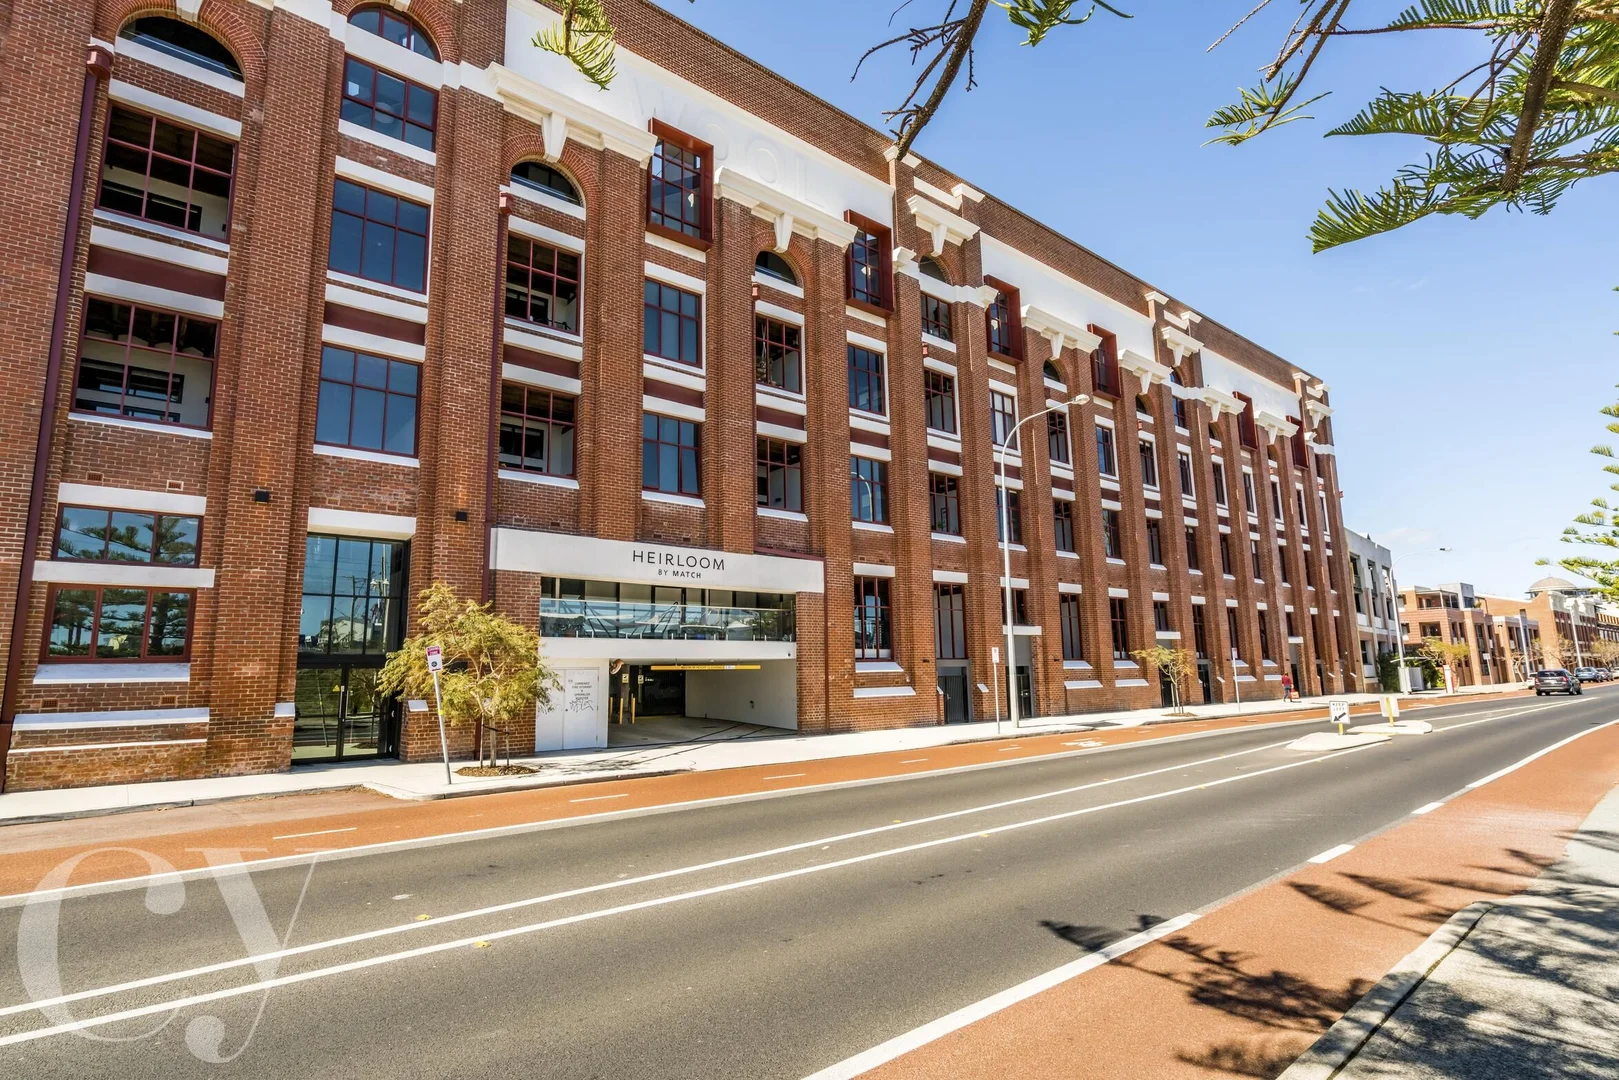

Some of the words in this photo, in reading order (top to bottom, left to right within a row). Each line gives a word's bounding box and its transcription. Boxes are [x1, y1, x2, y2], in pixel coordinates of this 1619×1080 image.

[632, 550, 725, 571] HEIRLOOM
[657, 568, 668, 576] BY
[672, 570, 701, 579] MATCH
